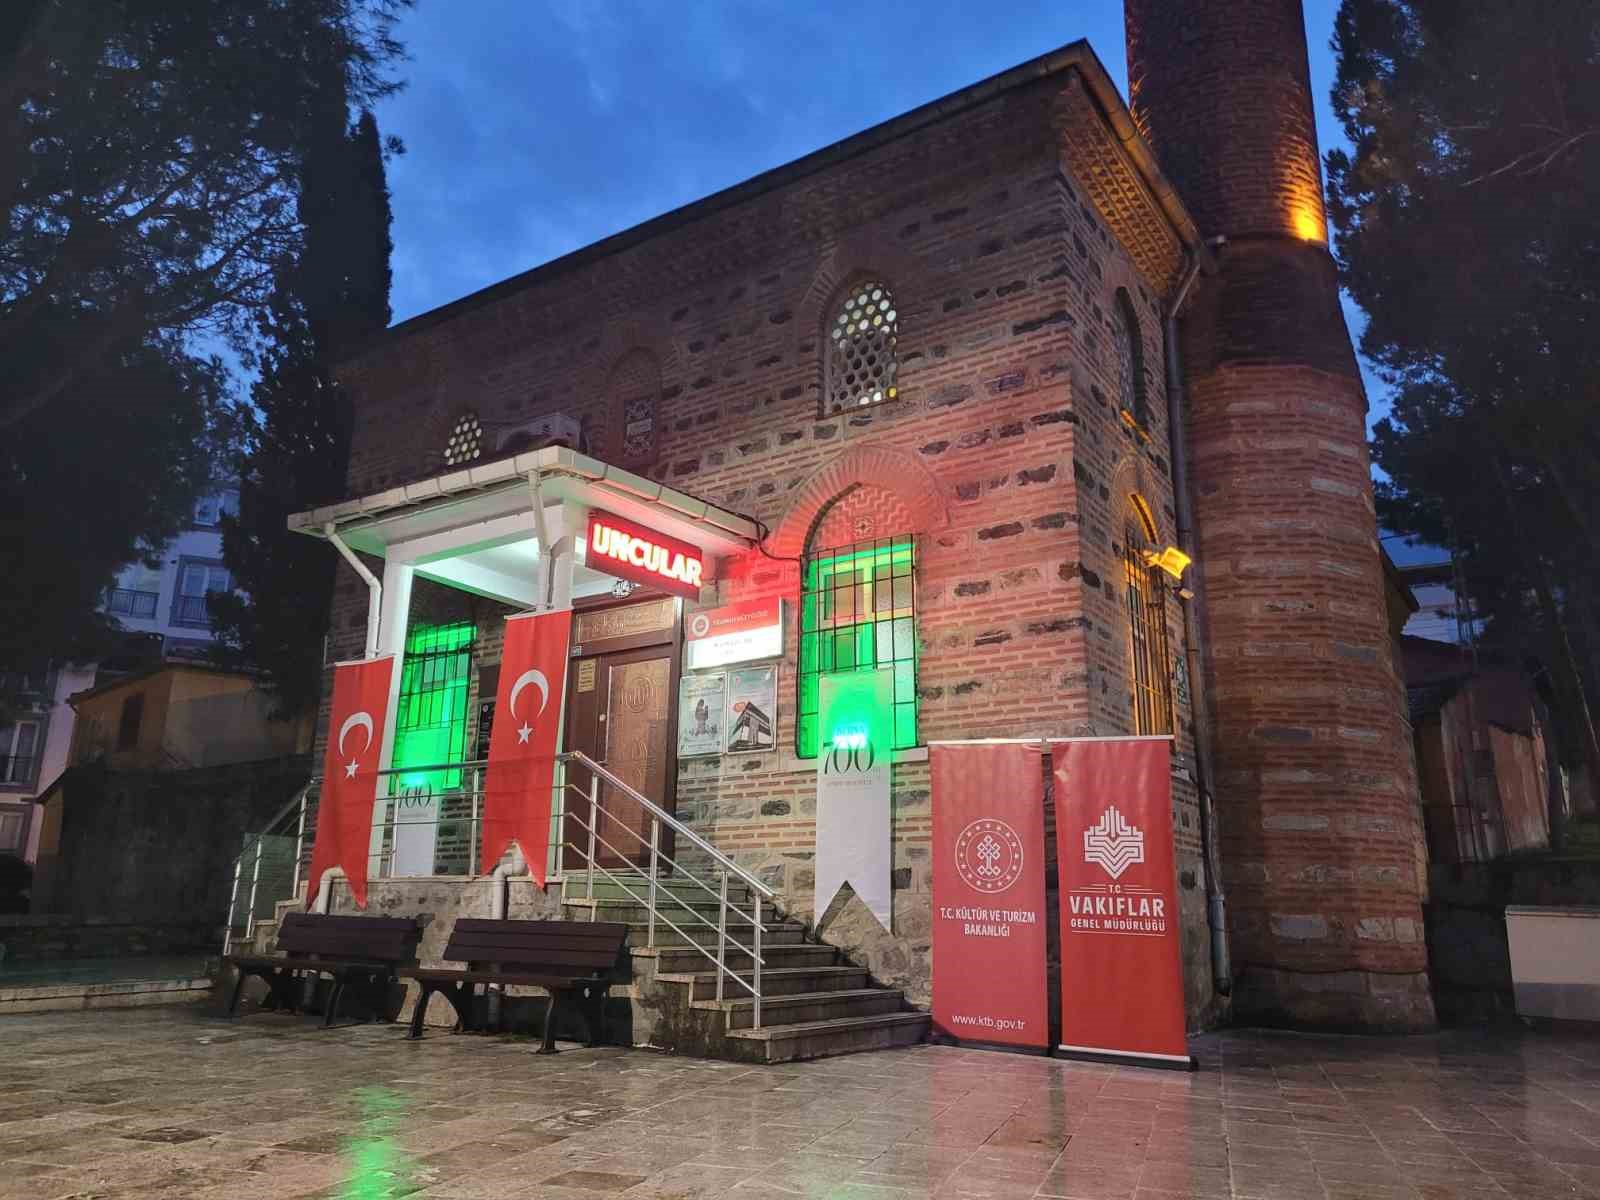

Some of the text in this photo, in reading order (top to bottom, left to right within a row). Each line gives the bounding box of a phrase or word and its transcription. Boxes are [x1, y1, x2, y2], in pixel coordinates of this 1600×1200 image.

[592, 523, 702, 588] UNCULAR
[822, 739, 875, 776] 700
[940, 905, 1036, 924] T.C. KÜLTÜR VE TURİZM
[1069, 895, 1165, 917] VAKIFLAR
[964, 922, 1010, 937] BAKANLIĞI
[1070, 916, 1166, 932] GENEL MÜDÜRLÜĞÜ
[951, 1014, 1025, 1031] www.ktb.gov.tr
